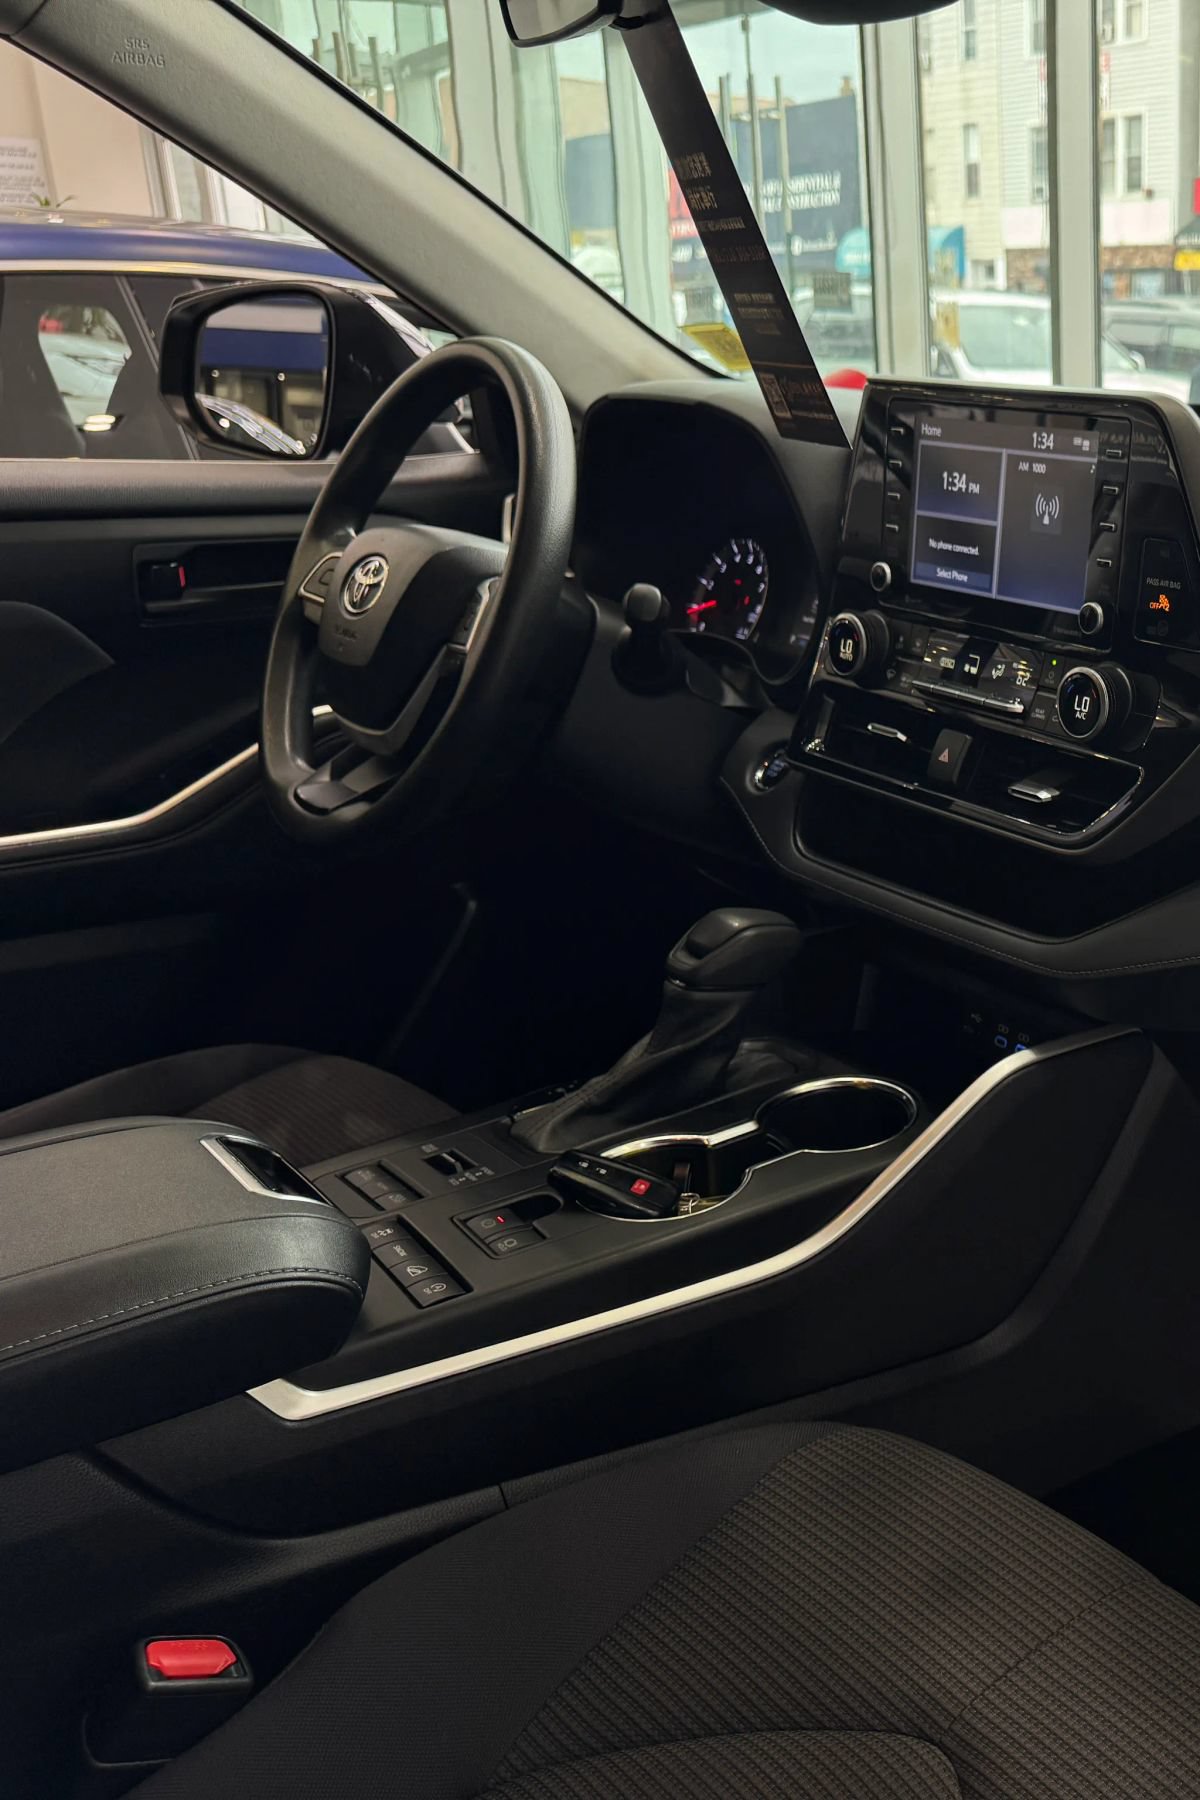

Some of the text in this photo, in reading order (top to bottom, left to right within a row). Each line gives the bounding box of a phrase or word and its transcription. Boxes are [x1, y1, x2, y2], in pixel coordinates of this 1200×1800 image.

[124, 37, 150, 49] SRS
[111, 51, 166, 68] AIRBAG
[921, 423, 942, 437] Home
[1032, 432, 1055, 450] 1:34
[1018, 461, 1047, 475] AM 1000
[942, 471, 980, 494] 1:34 PM
[929, 537, 938, 549] No
[937, 540, 952, 552] phone
[936, 567, 968, 582] Select Phone
[1146, 577, 1181, 590] PASS AIR BAG
[1074, 694, 1090, 712] LO
[1075, 711, 1087, 720] A/C
